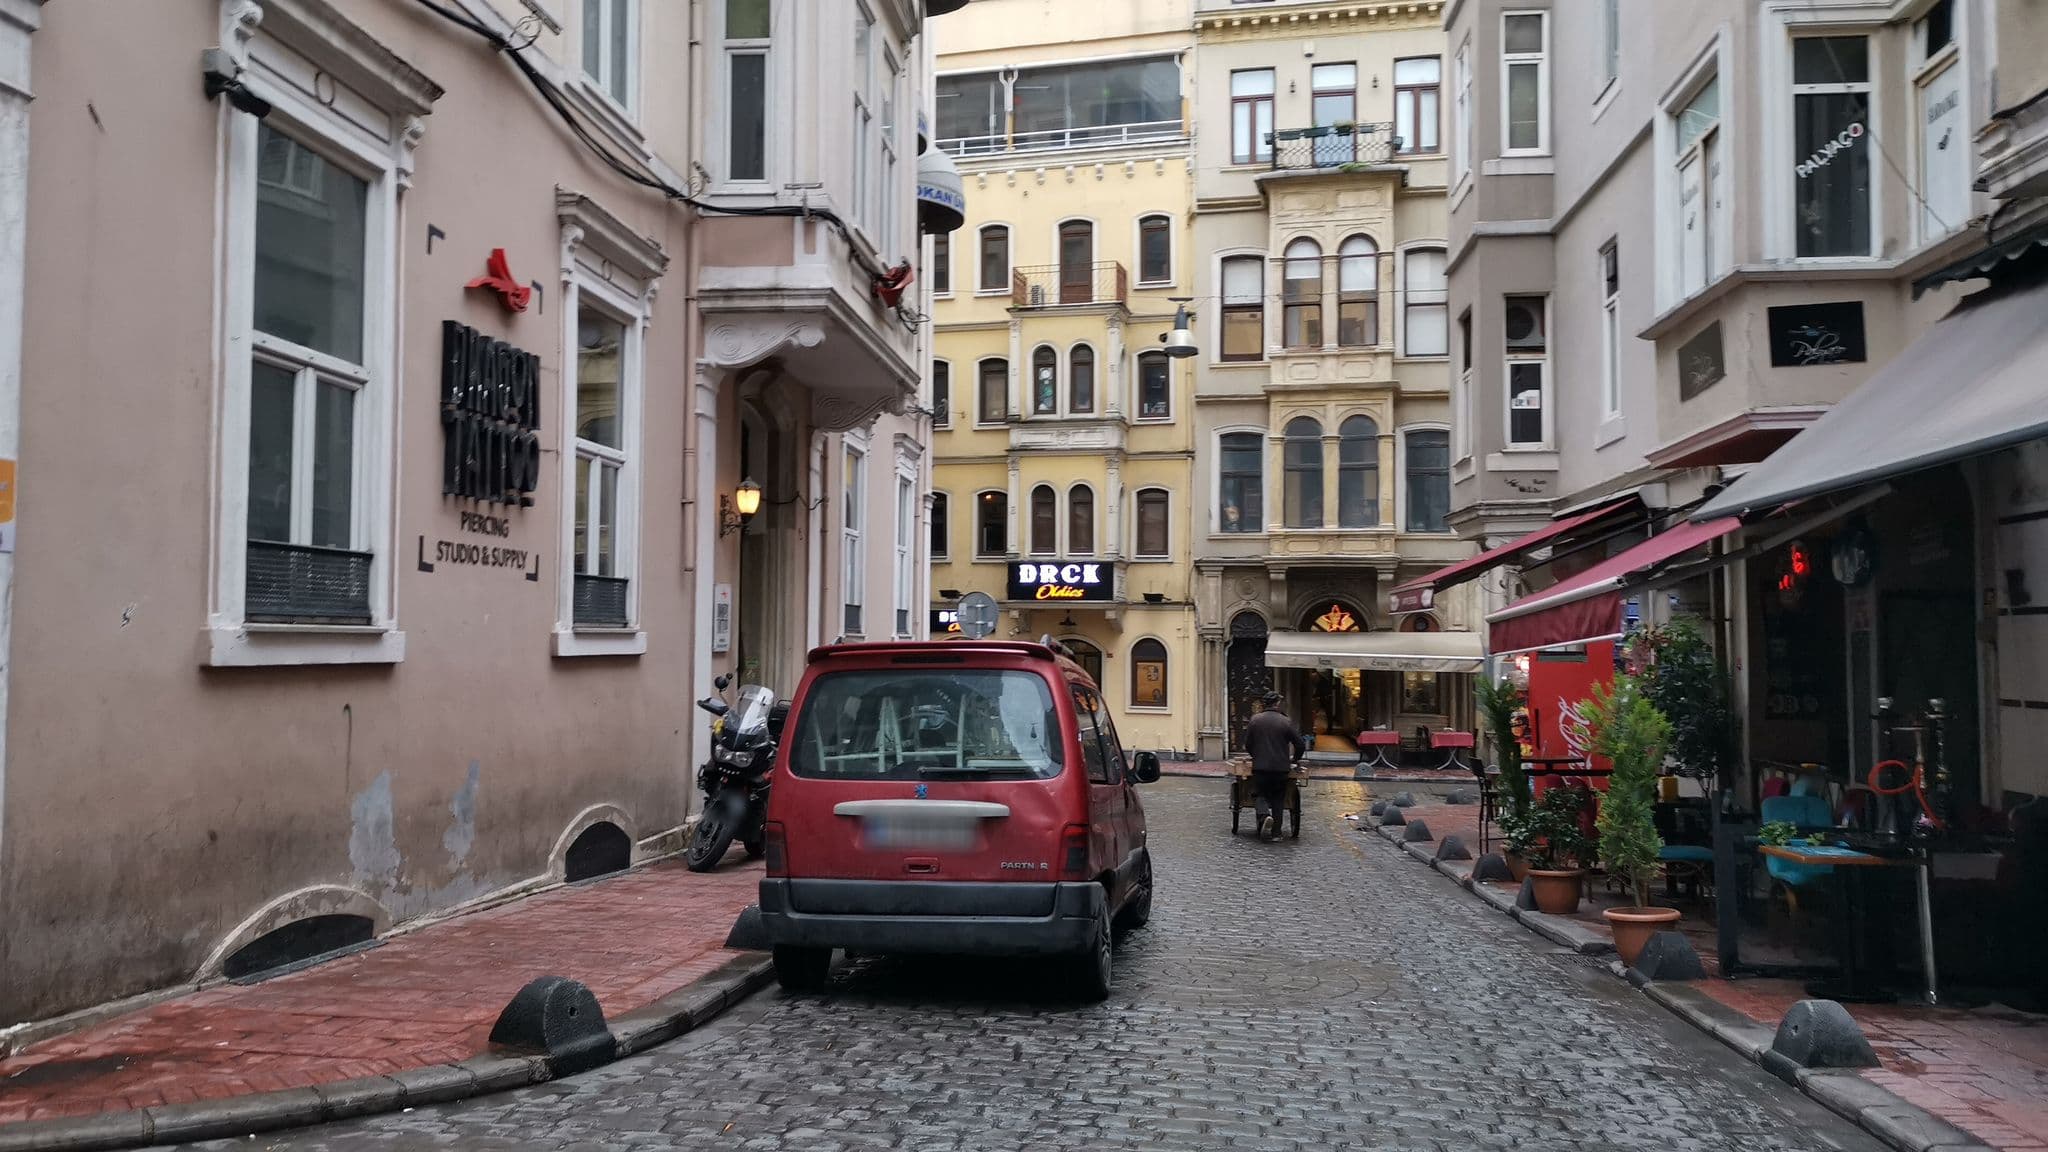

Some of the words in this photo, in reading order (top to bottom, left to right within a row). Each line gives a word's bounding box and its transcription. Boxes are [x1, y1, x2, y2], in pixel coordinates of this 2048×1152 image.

[461, 511, 510, 539] PIERCING
[436, 540, 480, 566] STUDIO
[481, 545, 490, 566] &
[492, 548, 528, 569] SUPPLY
[1018, 564, 1100, 583] DRCK
[1035, 583, 1085, 600] Oldies
